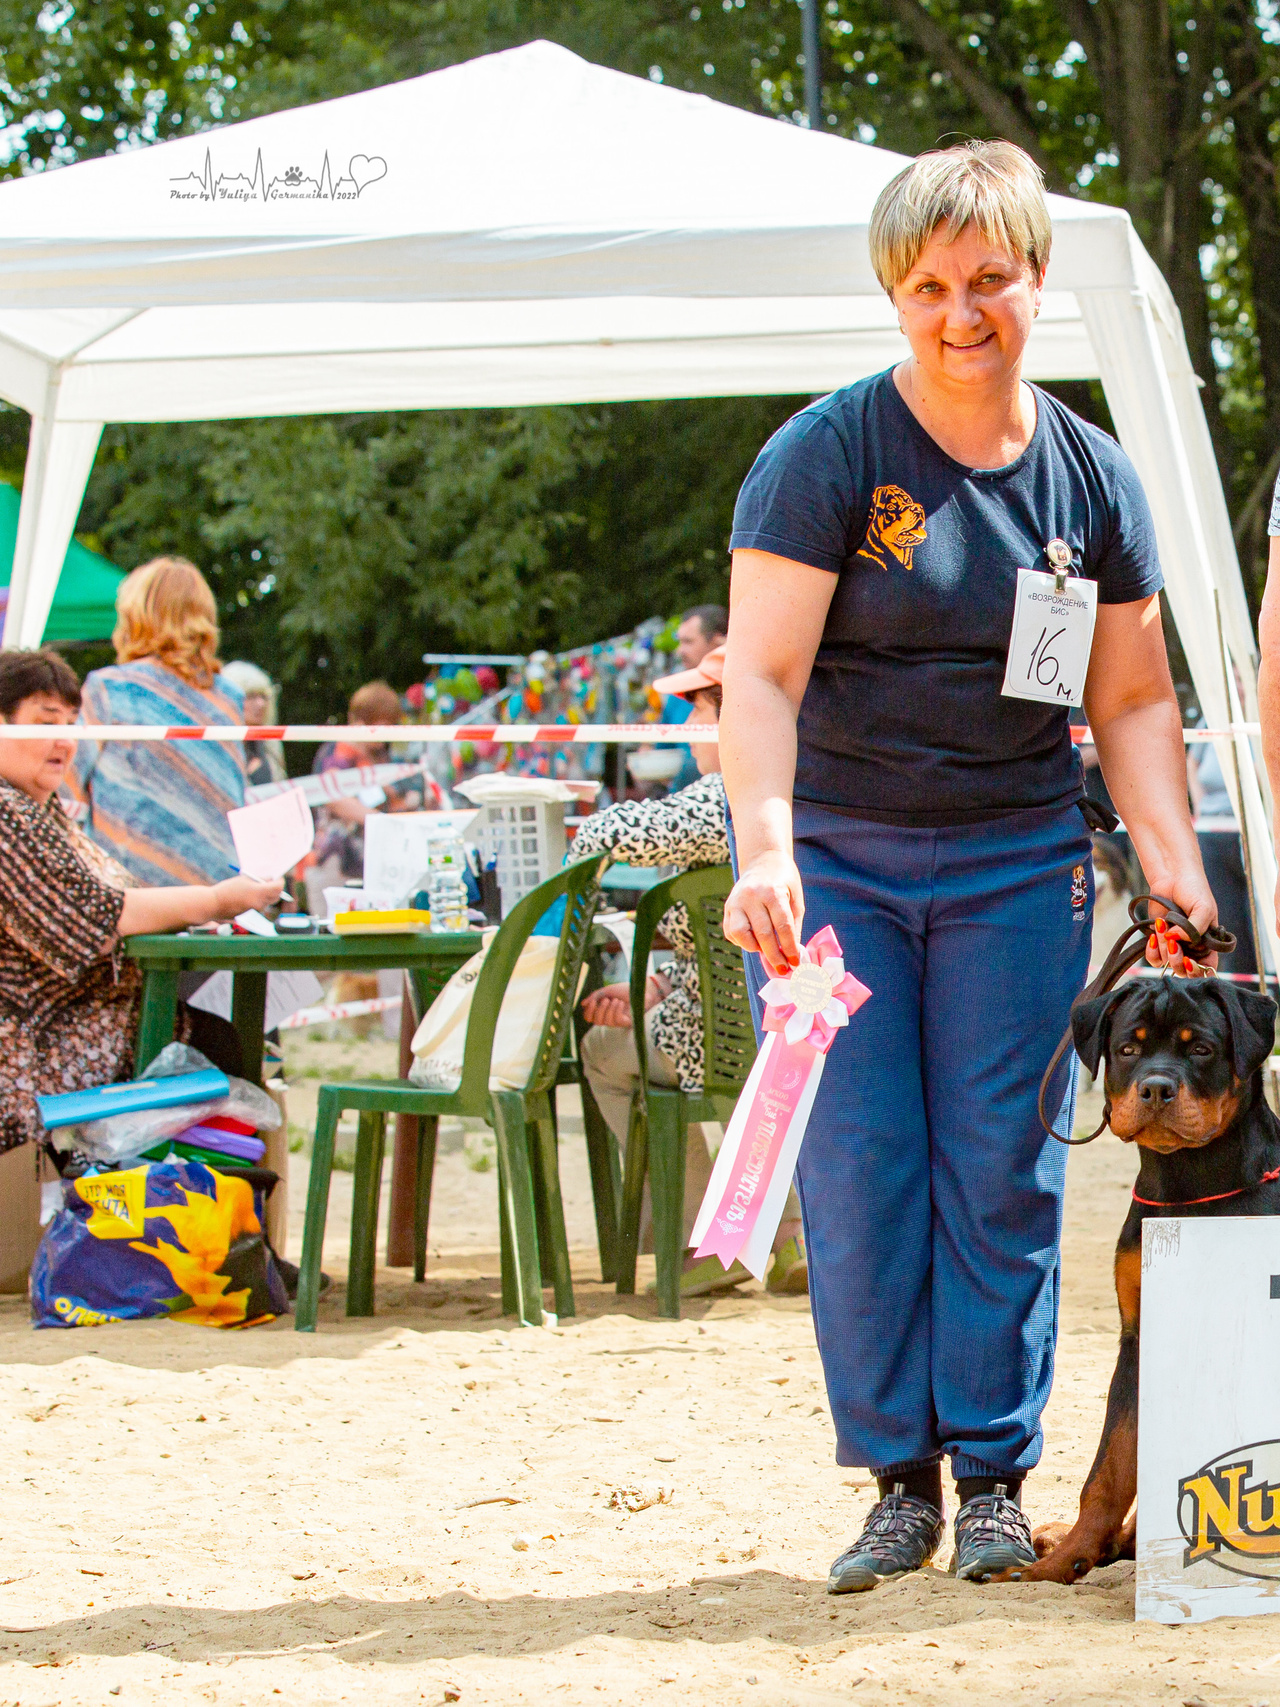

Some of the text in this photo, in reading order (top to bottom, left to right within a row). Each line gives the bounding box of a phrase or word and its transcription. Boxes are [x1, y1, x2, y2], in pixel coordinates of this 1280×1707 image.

[1027, 592, 1089, 610] «ВОЗРОЖДЕНИЕ
[1050, 607, 1070, 617] БИС»
[1026, 626, 1067, 686] 16
